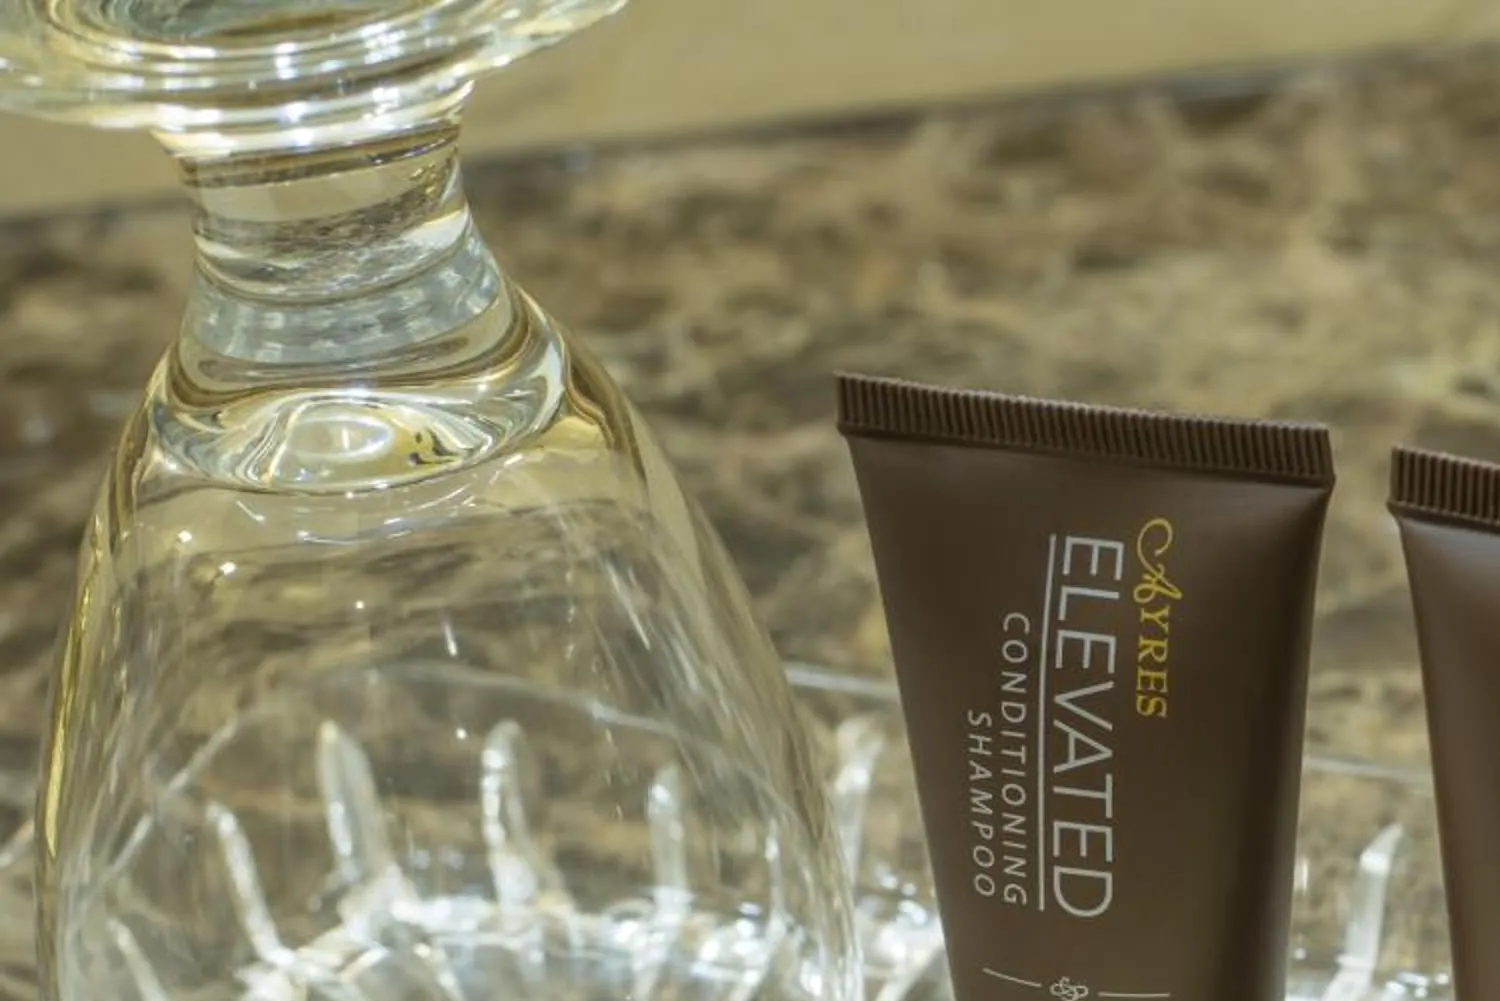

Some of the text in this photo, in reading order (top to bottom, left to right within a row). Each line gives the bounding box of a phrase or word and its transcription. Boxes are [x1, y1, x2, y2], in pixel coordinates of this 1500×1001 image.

[1053, 535, 1125, 918] ELEVATED
[1133, 517, 1183, 718] AYRES
[967, 709, 996, 897] SHAMPOO
[999, 612, 1031, 905] CONDITIONING
